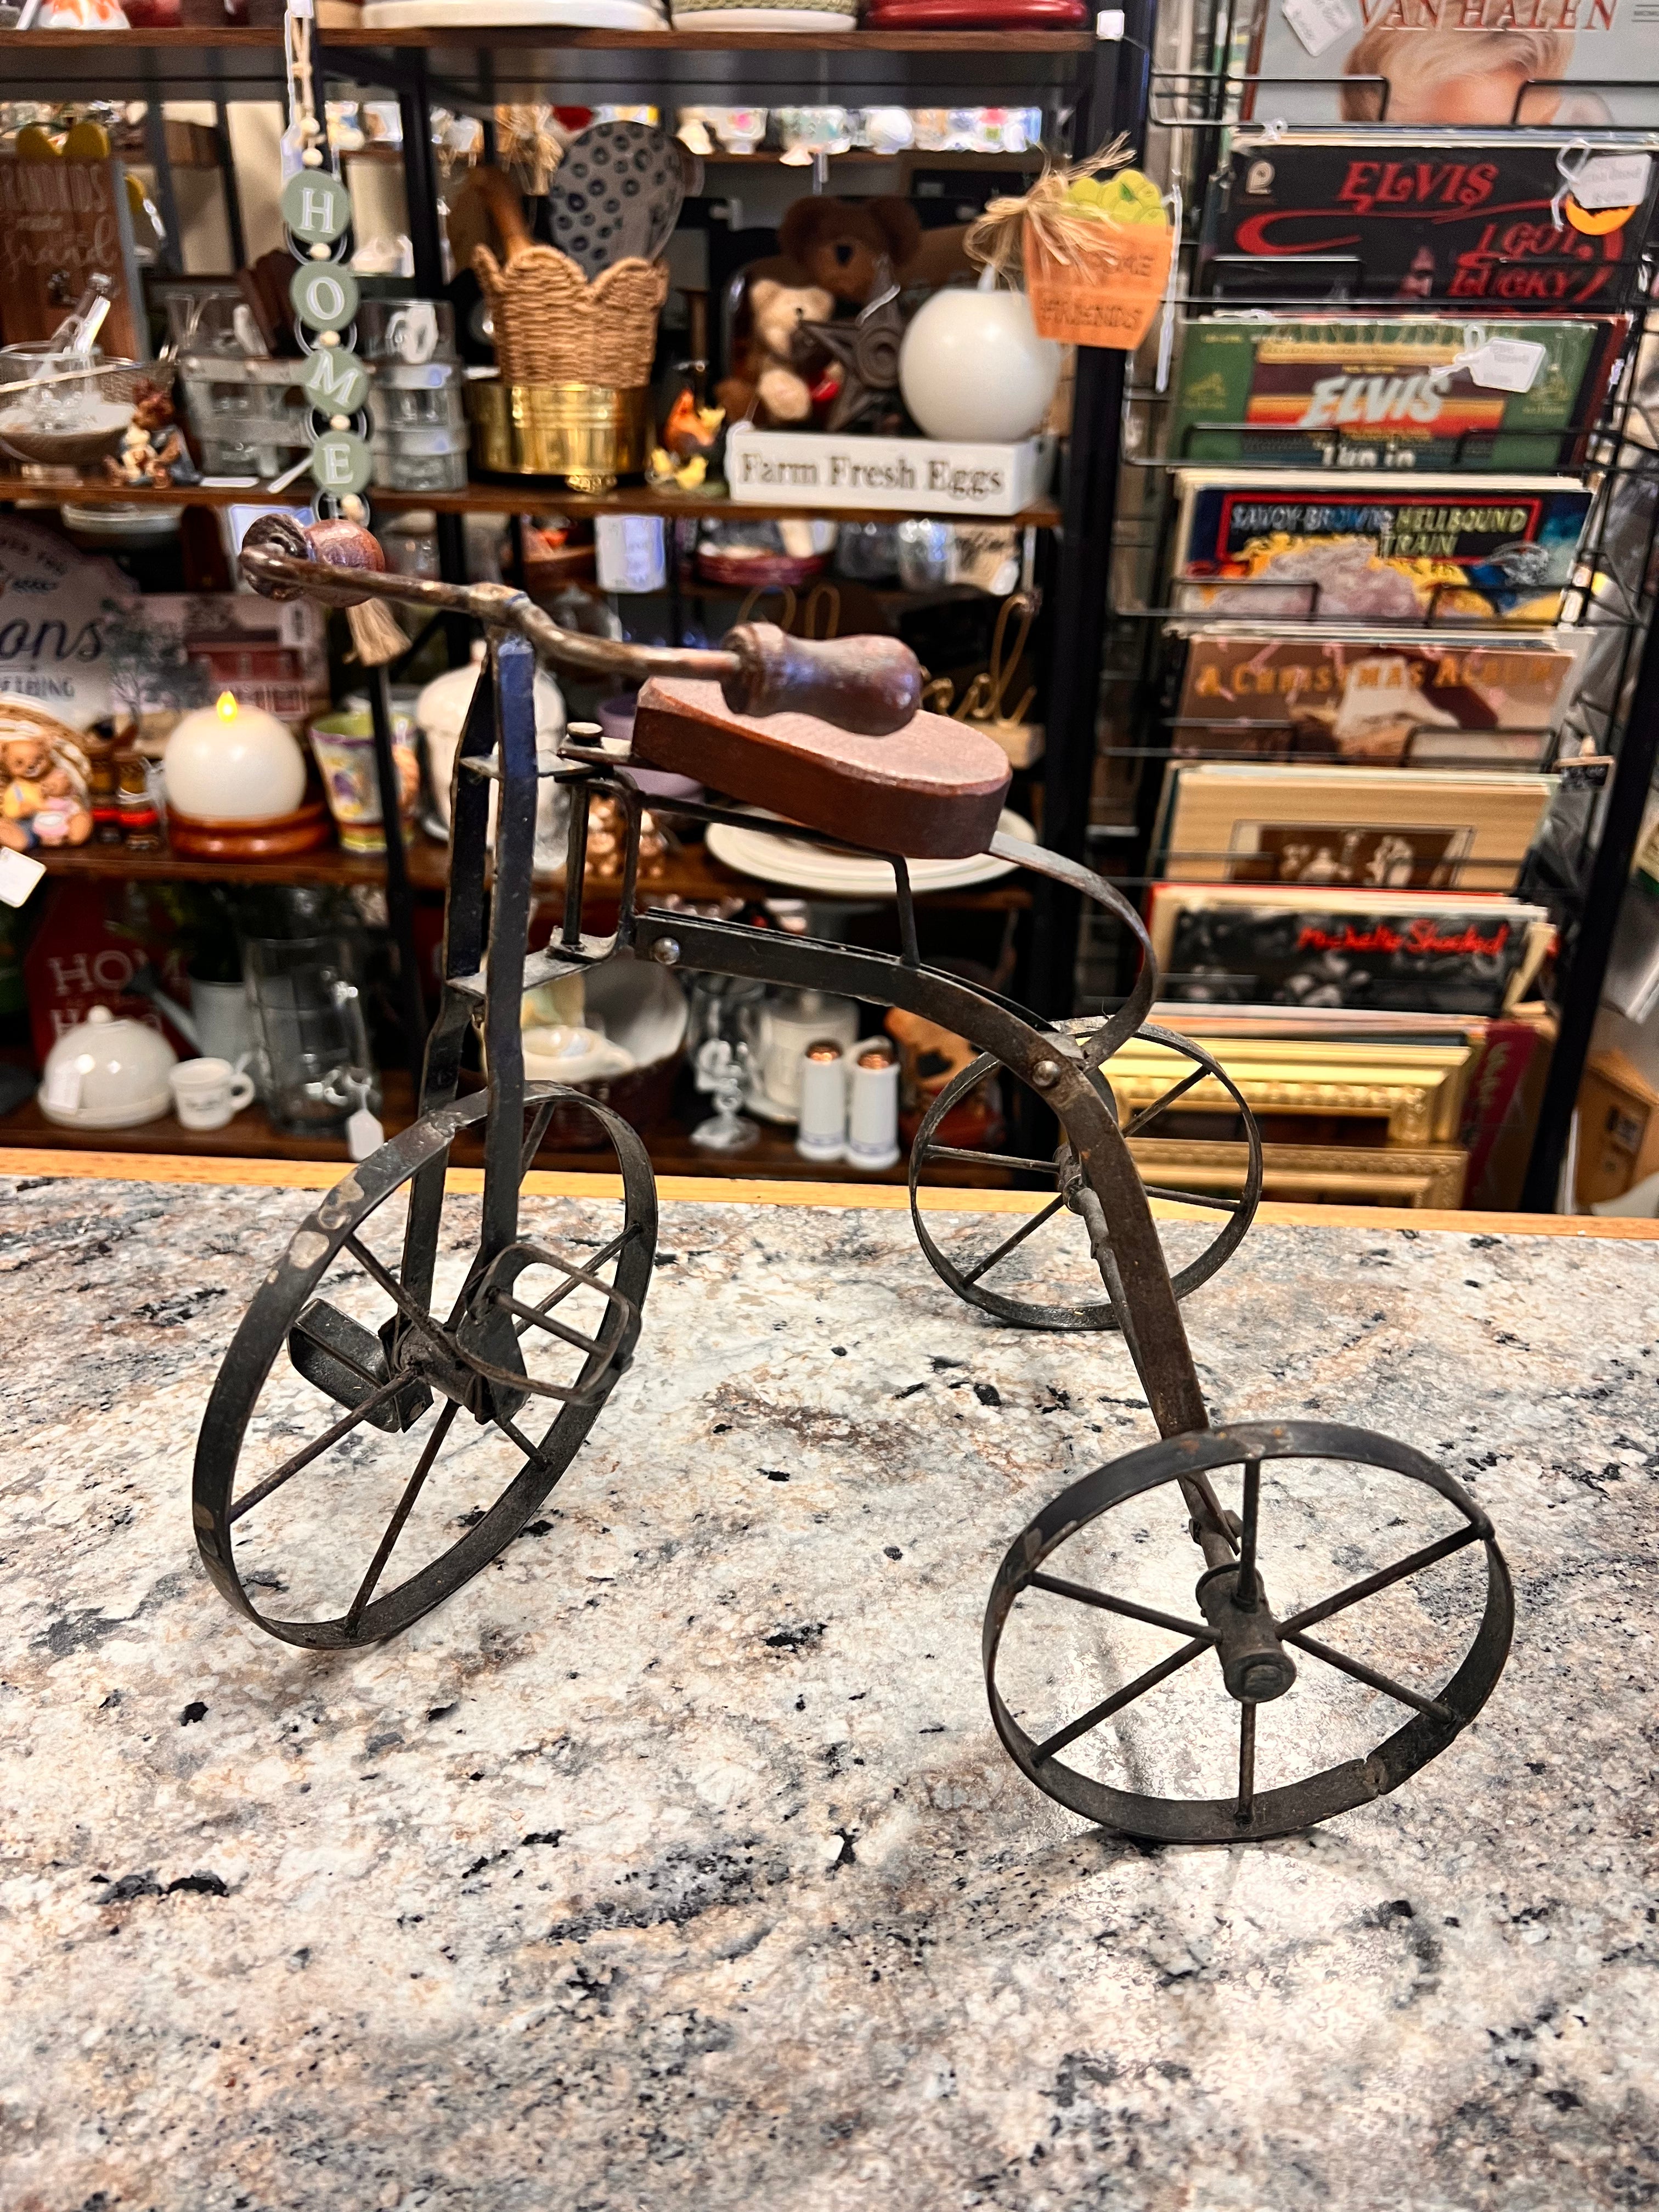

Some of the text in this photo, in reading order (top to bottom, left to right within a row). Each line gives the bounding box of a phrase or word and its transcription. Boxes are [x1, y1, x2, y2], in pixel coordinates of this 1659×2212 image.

[1361, 0, 1443, 31] VAN
[1455, 0, 1616, 31] HALEN
[1334, 161, 1501, 213] ELVIS
[299, 188, 358, 486] HOME
[1299, 374, 1454, 428] ELVIS
[740, 452, 1005, 498] Farm Fresh Eggs
[1396, 506, 1528, 533] HELLBOUND
[1194, 662, 1222, 698] A
